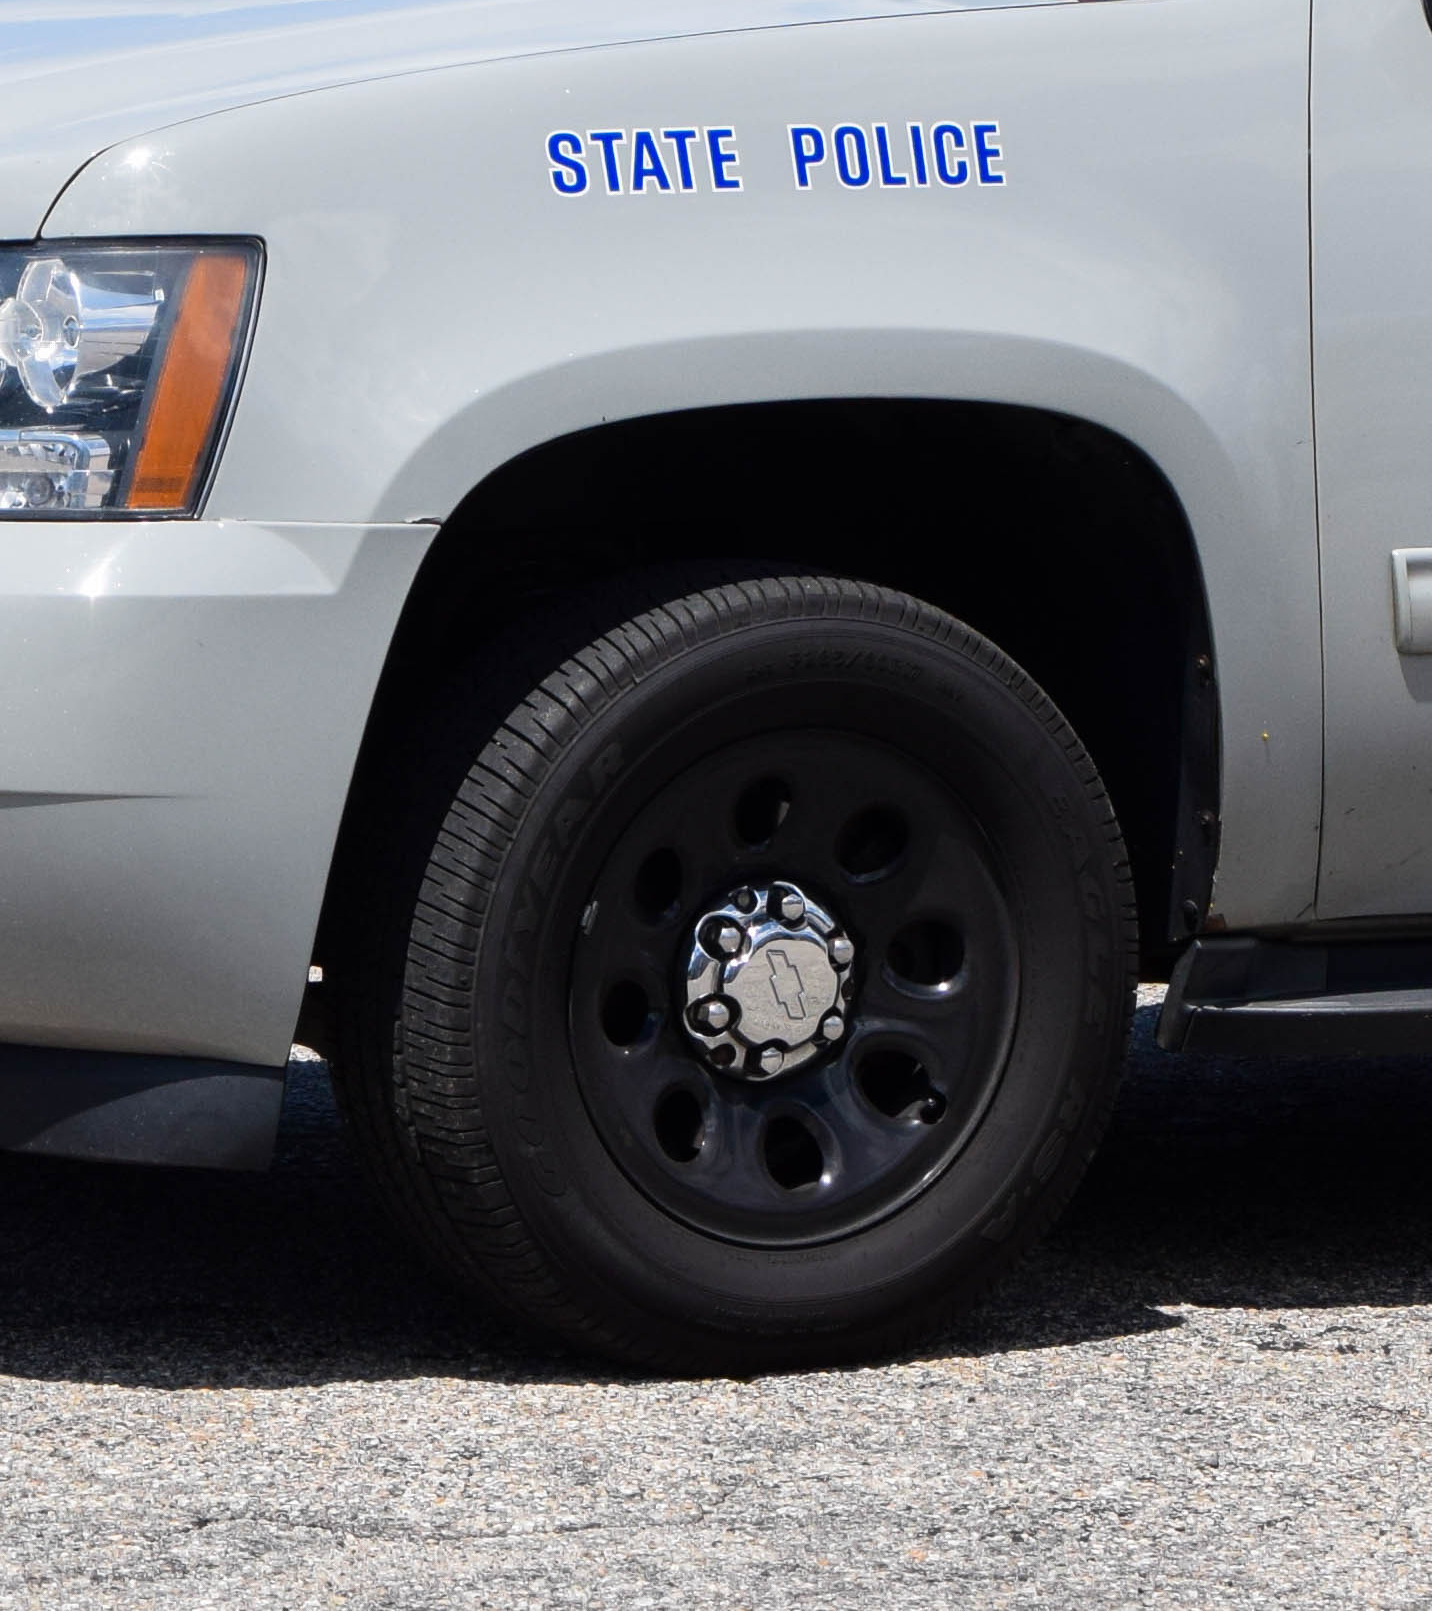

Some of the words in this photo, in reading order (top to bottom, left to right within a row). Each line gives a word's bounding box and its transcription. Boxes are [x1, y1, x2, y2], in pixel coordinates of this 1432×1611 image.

[546, 124, 744, 197] STATE
[787, 119, 1006, 190] POLICE
[503, 742, 625, 1192] GOODYEAR
